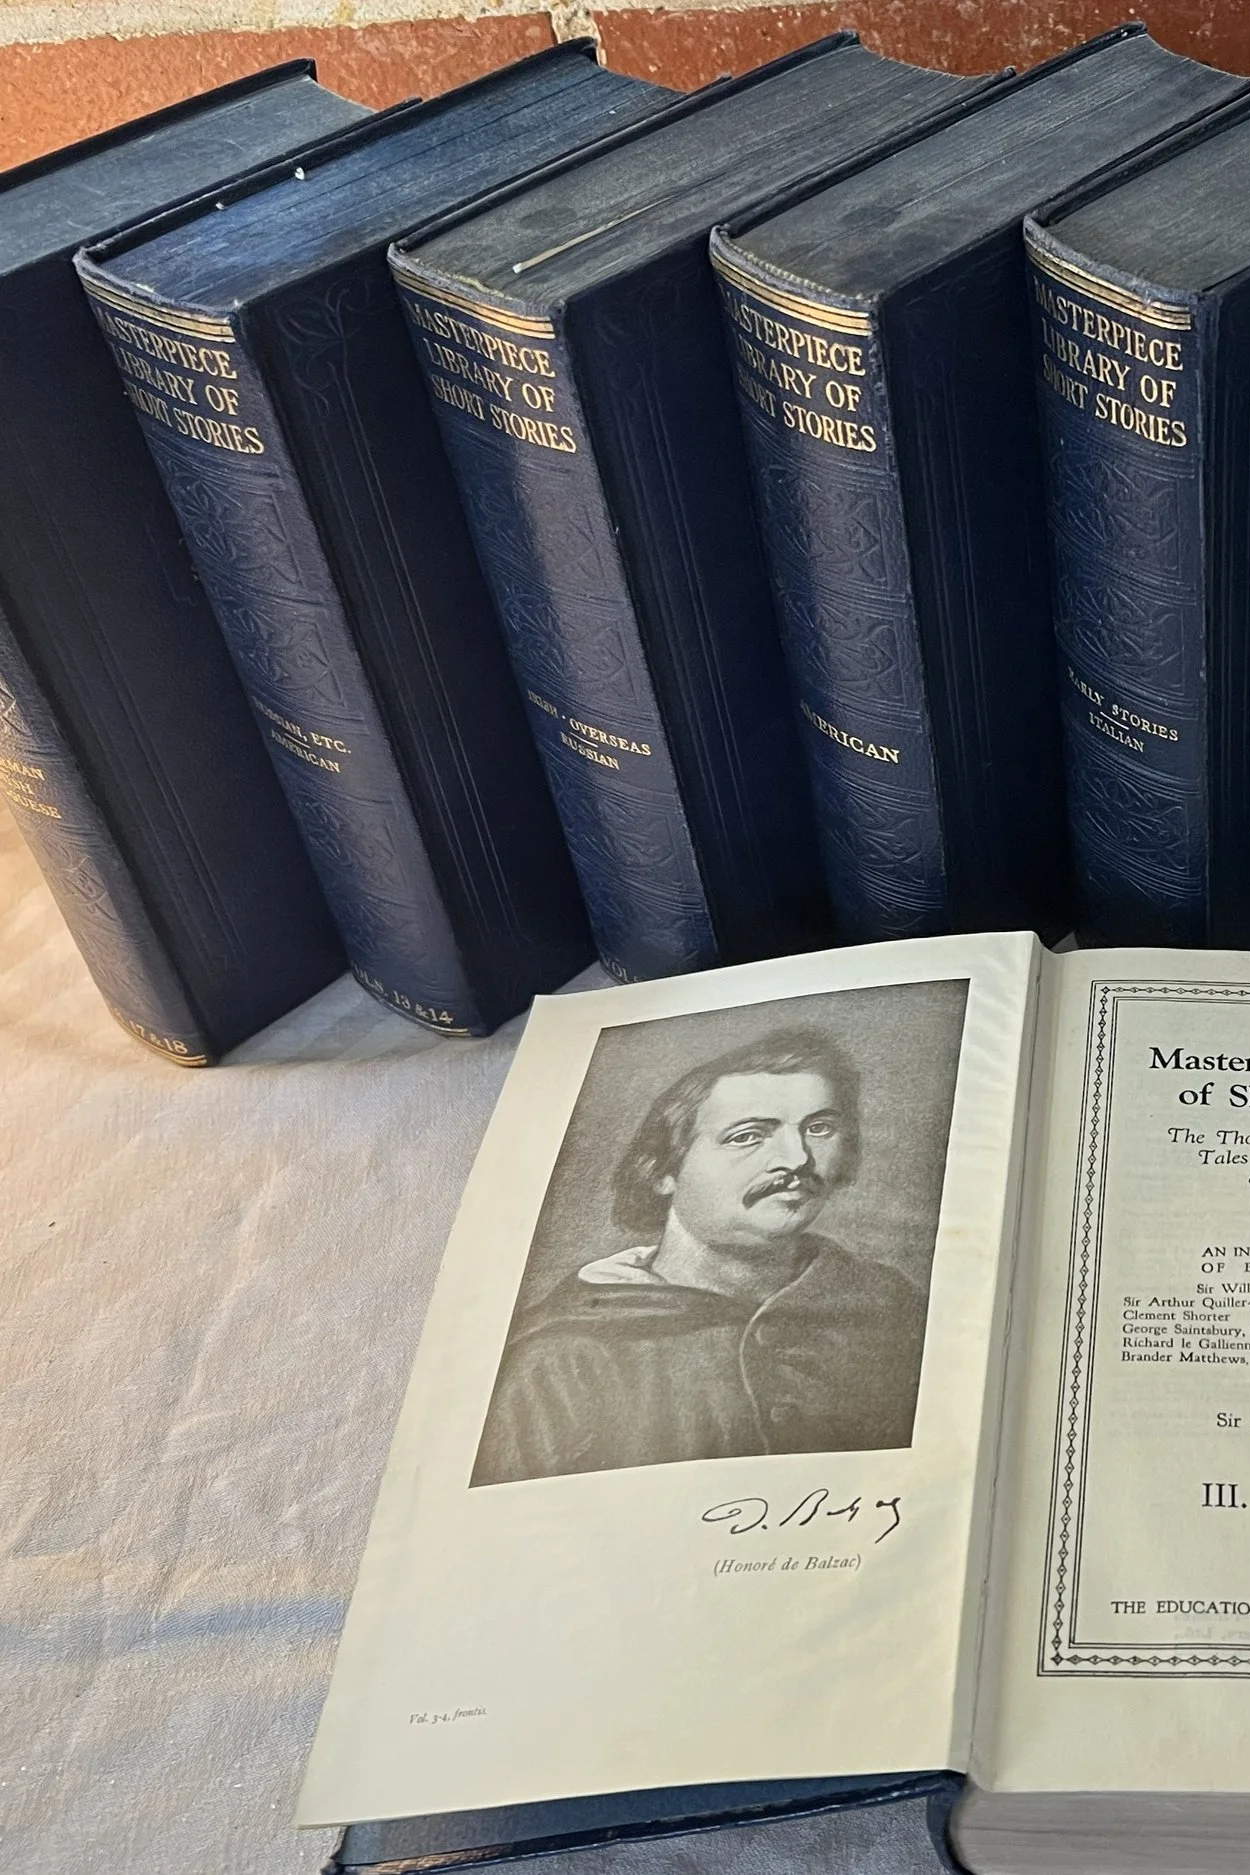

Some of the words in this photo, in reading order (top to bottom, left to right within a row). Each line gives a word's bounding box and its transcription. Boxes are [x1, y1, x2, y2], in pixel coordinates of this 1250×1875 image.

[1042, 317, 1131, 390] LIBRARY
[1140, 375, 1176, 407] OF
[424, 338, 513, 401] LIBRARY
[522, 383, 555, 412] OF
[205, 385, 238, 415] OF
[826, 381, 861, 411] OF
[1043, 354, 1088, 409] SHORT
[1096, 393, 1187, 446] STORIES
[431, 374, 485, 420] SHORT
[490, 404, 576, 453] STORIES
[173, 408, 264, 454] STORIES
[783, 401, 876, 452] STORIES
[1089, 712, 1144, 752] ITALIAN
[1112, 704, 1178, 741] STORIES
[310, 732, 351, 753] ETC.
[570, 718, 651, 755] OVERSEAS
[560, 731, 619, 770] RUSSIAN
[1178, 1081, 1215, 1106] of
[1167, 1127, 1205, 1145] The
[1198, 1149, 1248, 1165] Tales
[1201, 1246, 1226, 1258] AN
[1201, 1262, 1225, 1274] OF
[1196, 1283, 1214, 1294] Sir
[1123, 1296, 1141, 1307] Sir
[1147, 1296, 1195, 1308] Arthur
[1122, 1309, 1176, 1321] Clement
[1182, 1310, 1231, 1322] Shorter
[1122, 1323, 1168, 1336] George
[1174, 1323, 1246, 1338] Saintsbury,
[1123, 1336, 1174, 1348] Richard
[1181, 1337, 1192, 1349] le
[1121, 1350, 1173, 1363] Brander
[1179, 1351, 1249, 1366] Matthews,
[1216, 1412, 1242, 1428] Sir
[1201, 1482, 1248, 1509] III.
[714, 1557, 776, 1577] (Honoré
[781, 1558, 799, 1570] de
[805, 1554, 861, 1574] Balzac)
[1110, 1600, 1146, 1614] THE
